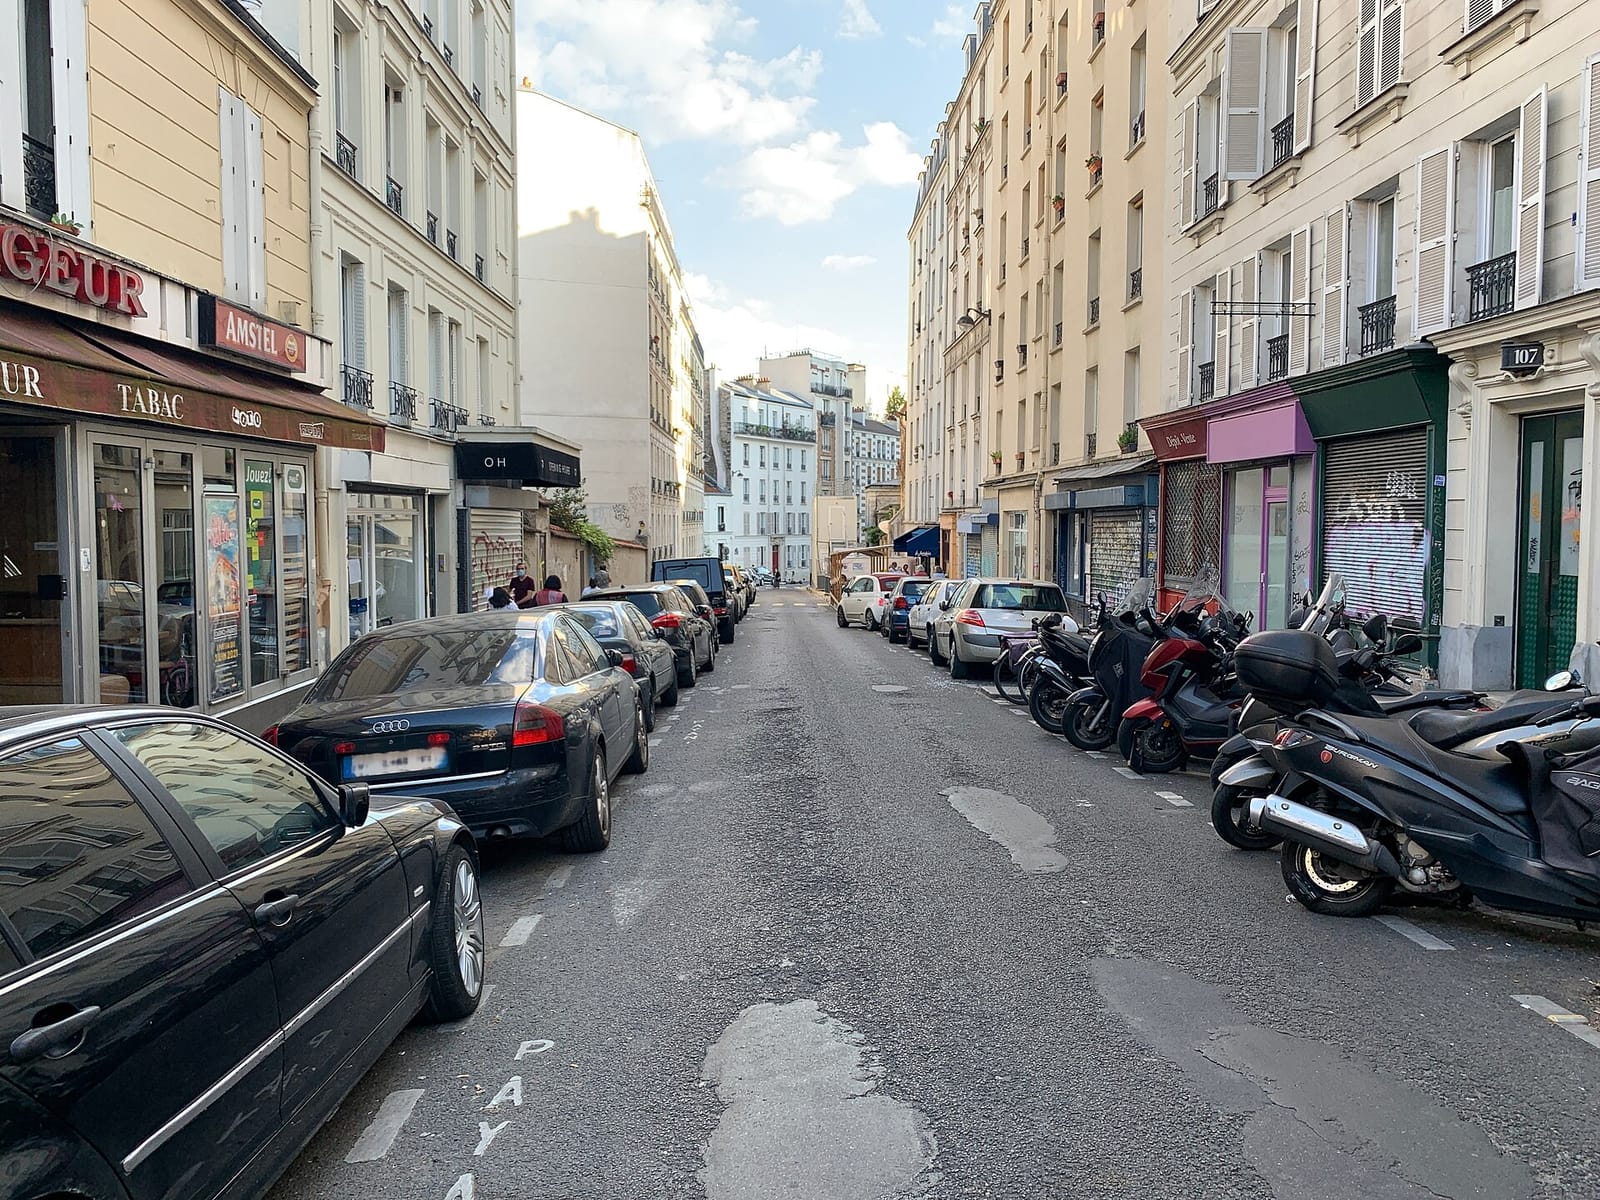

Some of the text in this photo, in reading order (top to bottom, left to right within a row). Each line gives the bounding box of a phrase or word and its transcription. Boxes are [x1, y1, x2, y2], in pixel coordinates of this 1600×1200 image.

[0, 225, 148, 318] GEUR
[225, 311, 278, 355] AMSTEL
[1514, 348, 1538, 364] 107
[117, 383, 184, 420] TABAC
[231, 406, 261, 428] LOTO
[245, 465, 272, 484] Jouez!
